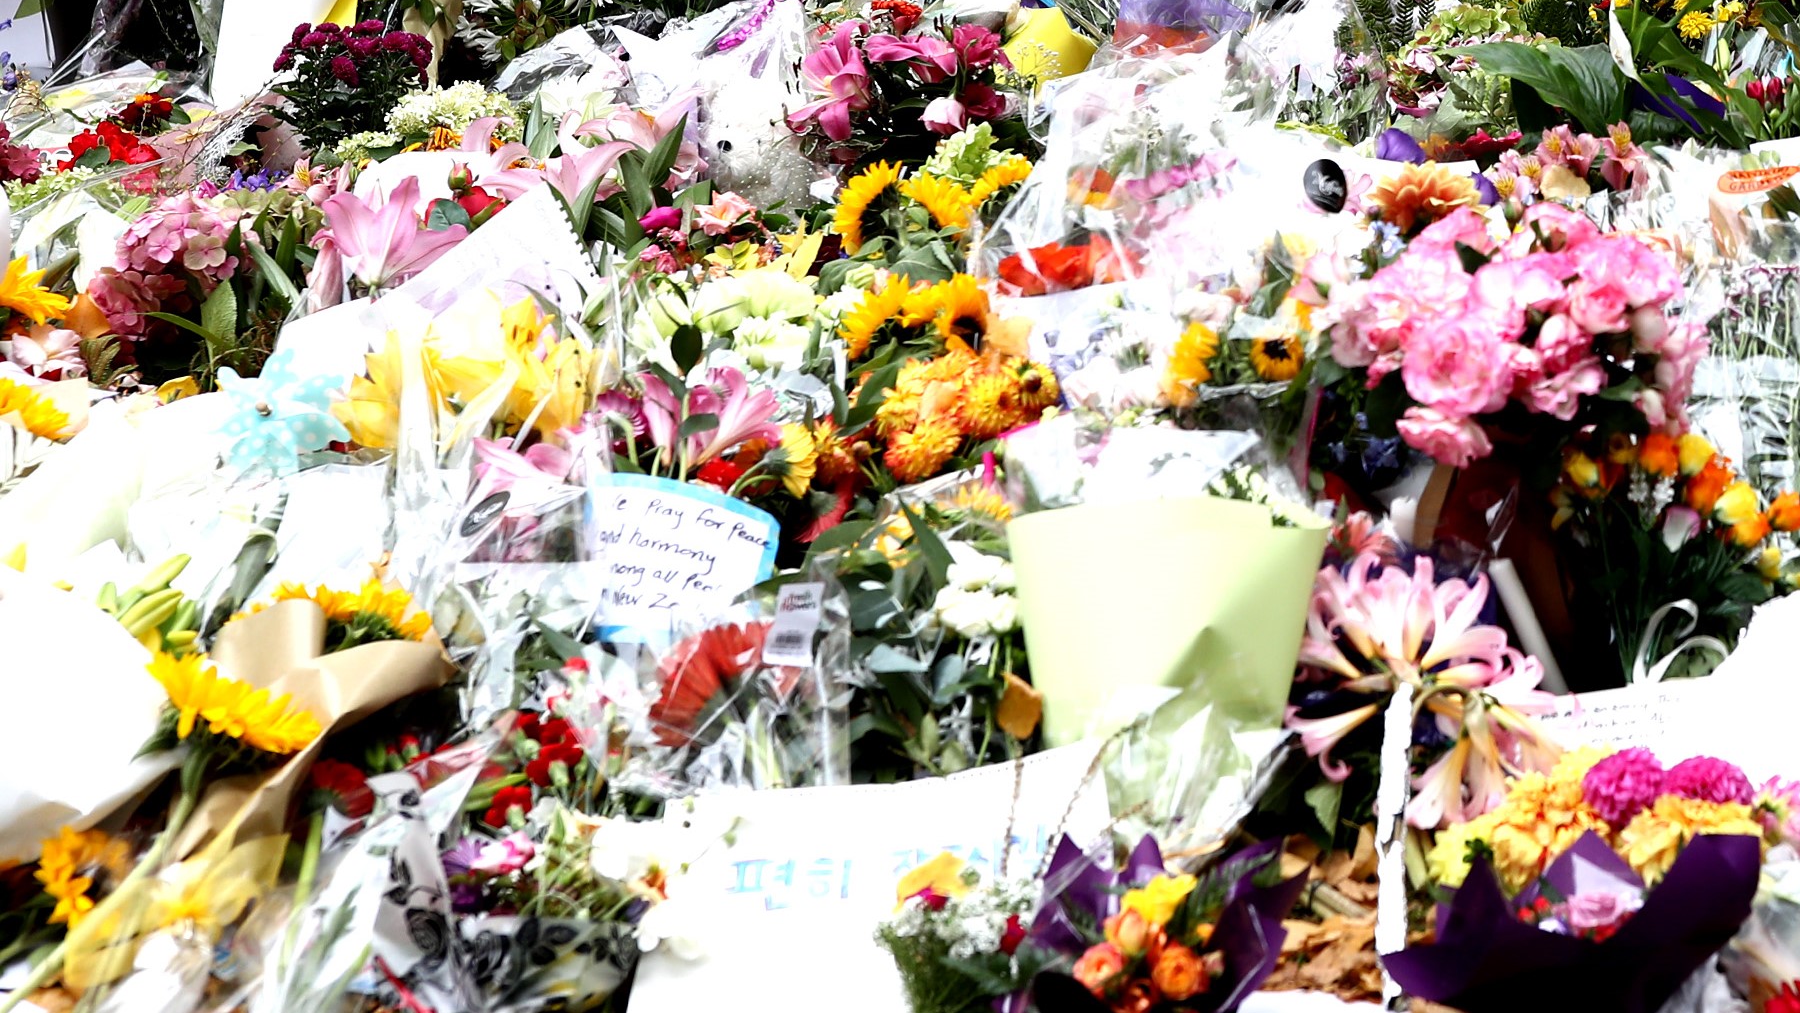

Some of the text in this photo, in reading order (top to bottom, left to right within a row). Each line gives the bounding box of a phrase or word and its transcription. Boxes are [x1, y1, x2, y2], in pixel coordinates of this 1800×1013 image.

[645, 498, 684, 530] Pray
[696, 508, 725, 530] for
[728, 522, 773, 551] Peace
[629, 527, 716, 576] harmony
[652, 569, 679, 583] all
